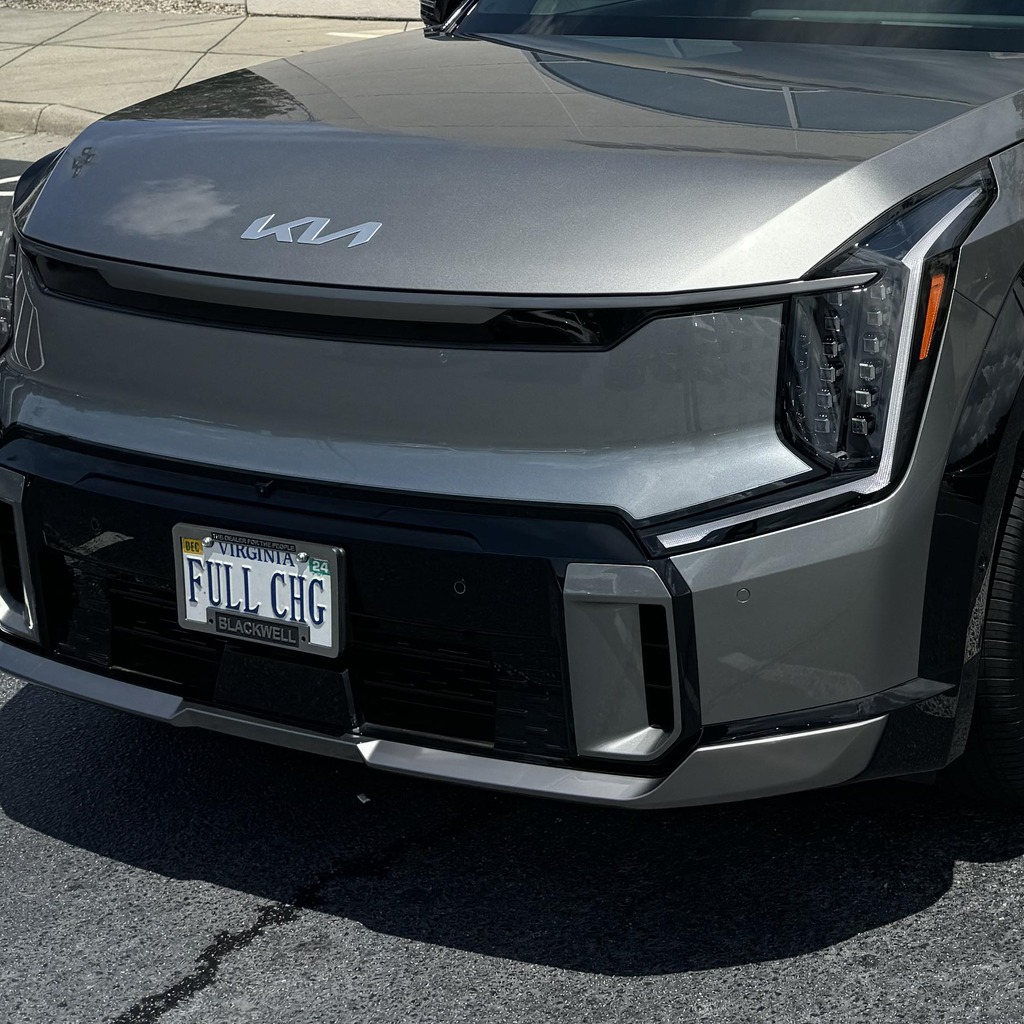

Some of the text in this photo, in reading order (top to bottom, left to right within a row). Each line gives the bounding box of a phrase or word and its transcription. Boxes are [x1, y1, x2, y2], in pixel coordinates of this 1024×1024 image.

[240, 213, 383, 248] KIA
[185, 541, 200, 552] DEC
[218, 542, 295, 567] VIRGINIA
[312, 561, 329, 573] 24
[187, 558, 326, 625] FULL CHG
[219, 616, 297, 643] BLACKWELL
